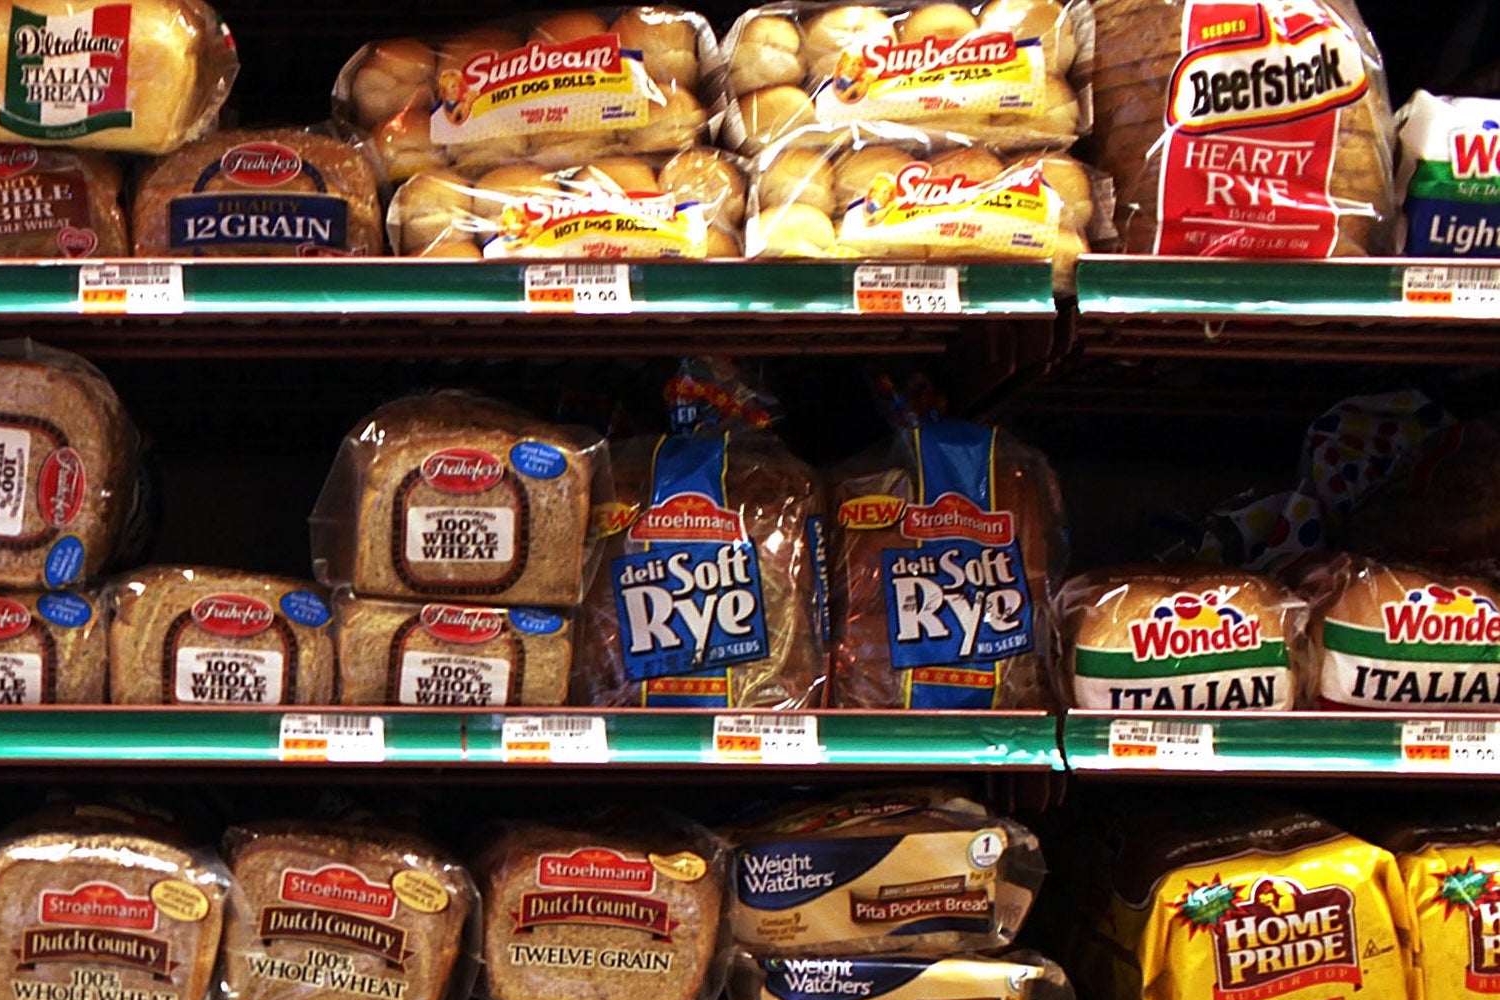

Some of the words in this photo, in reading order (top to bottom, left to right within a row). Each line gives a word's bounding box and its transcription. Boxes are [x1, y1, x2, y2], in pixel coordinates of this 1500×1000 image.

[1201, 20, 1246, 39] SEEDED
[20, 65, 111, 86] ITALIAN
[464, 43, 617, 92] Sunbeam
[491, 88, 518, 104] HOT
[521, 79, 550, 96] DOG
[553, 73, 596, 90] ROLLS
[1190, 45, 1352, 117] Beefsteak
[26, 85, 106, 103] BREAD
[1184, 142, 1314, 176] HEARTY
[1205, 173, 1297, 206] RYE
[216, 200, 299, 213] HEARTY
[1229, 209, 1276, 222] Bread
[839, 500, 903, 525] NEW
[912, 512, 1004, 535] Stroehmann
[435, 518, 487, 533] 100%
[422, 531, 498, 548] WHOLE
[421, 546, 498, 560] WHEAT
[619, 555, 665, 586] deli
[668, 547, 751, 596] Soft
[892, 555, 936, 577] deli
[939, 547, 1013, 589] Soft
[621, 586, 757, 665] Rye
[894, 575, 1023, 657] Rye
[1384, 604, 1500, 642] Wonde
[997, 633, 1029, 652] SEEDS
[1130, 617, 1261, 661] Wonder
[1109, 675, 1276, 711] ITALIAN
[545, 863, 646, 881] Stroehmann
[744, 853, 812, 877] Weight
[745, 870, 833, 894] Watchers
[856, 904, 886, 920] Pita
[890, 900, 941, 919] Pocket
[944, 896, 989, 912] Bread
[1225, 905, 1344, 950] HOME
[509, 946, 594, 967] TWELVE
[599, 950, 672, 972] GRAIN
[1227, 933, 1348, 984] PRIDE
[1313, 966, 1348, 981] TOP
